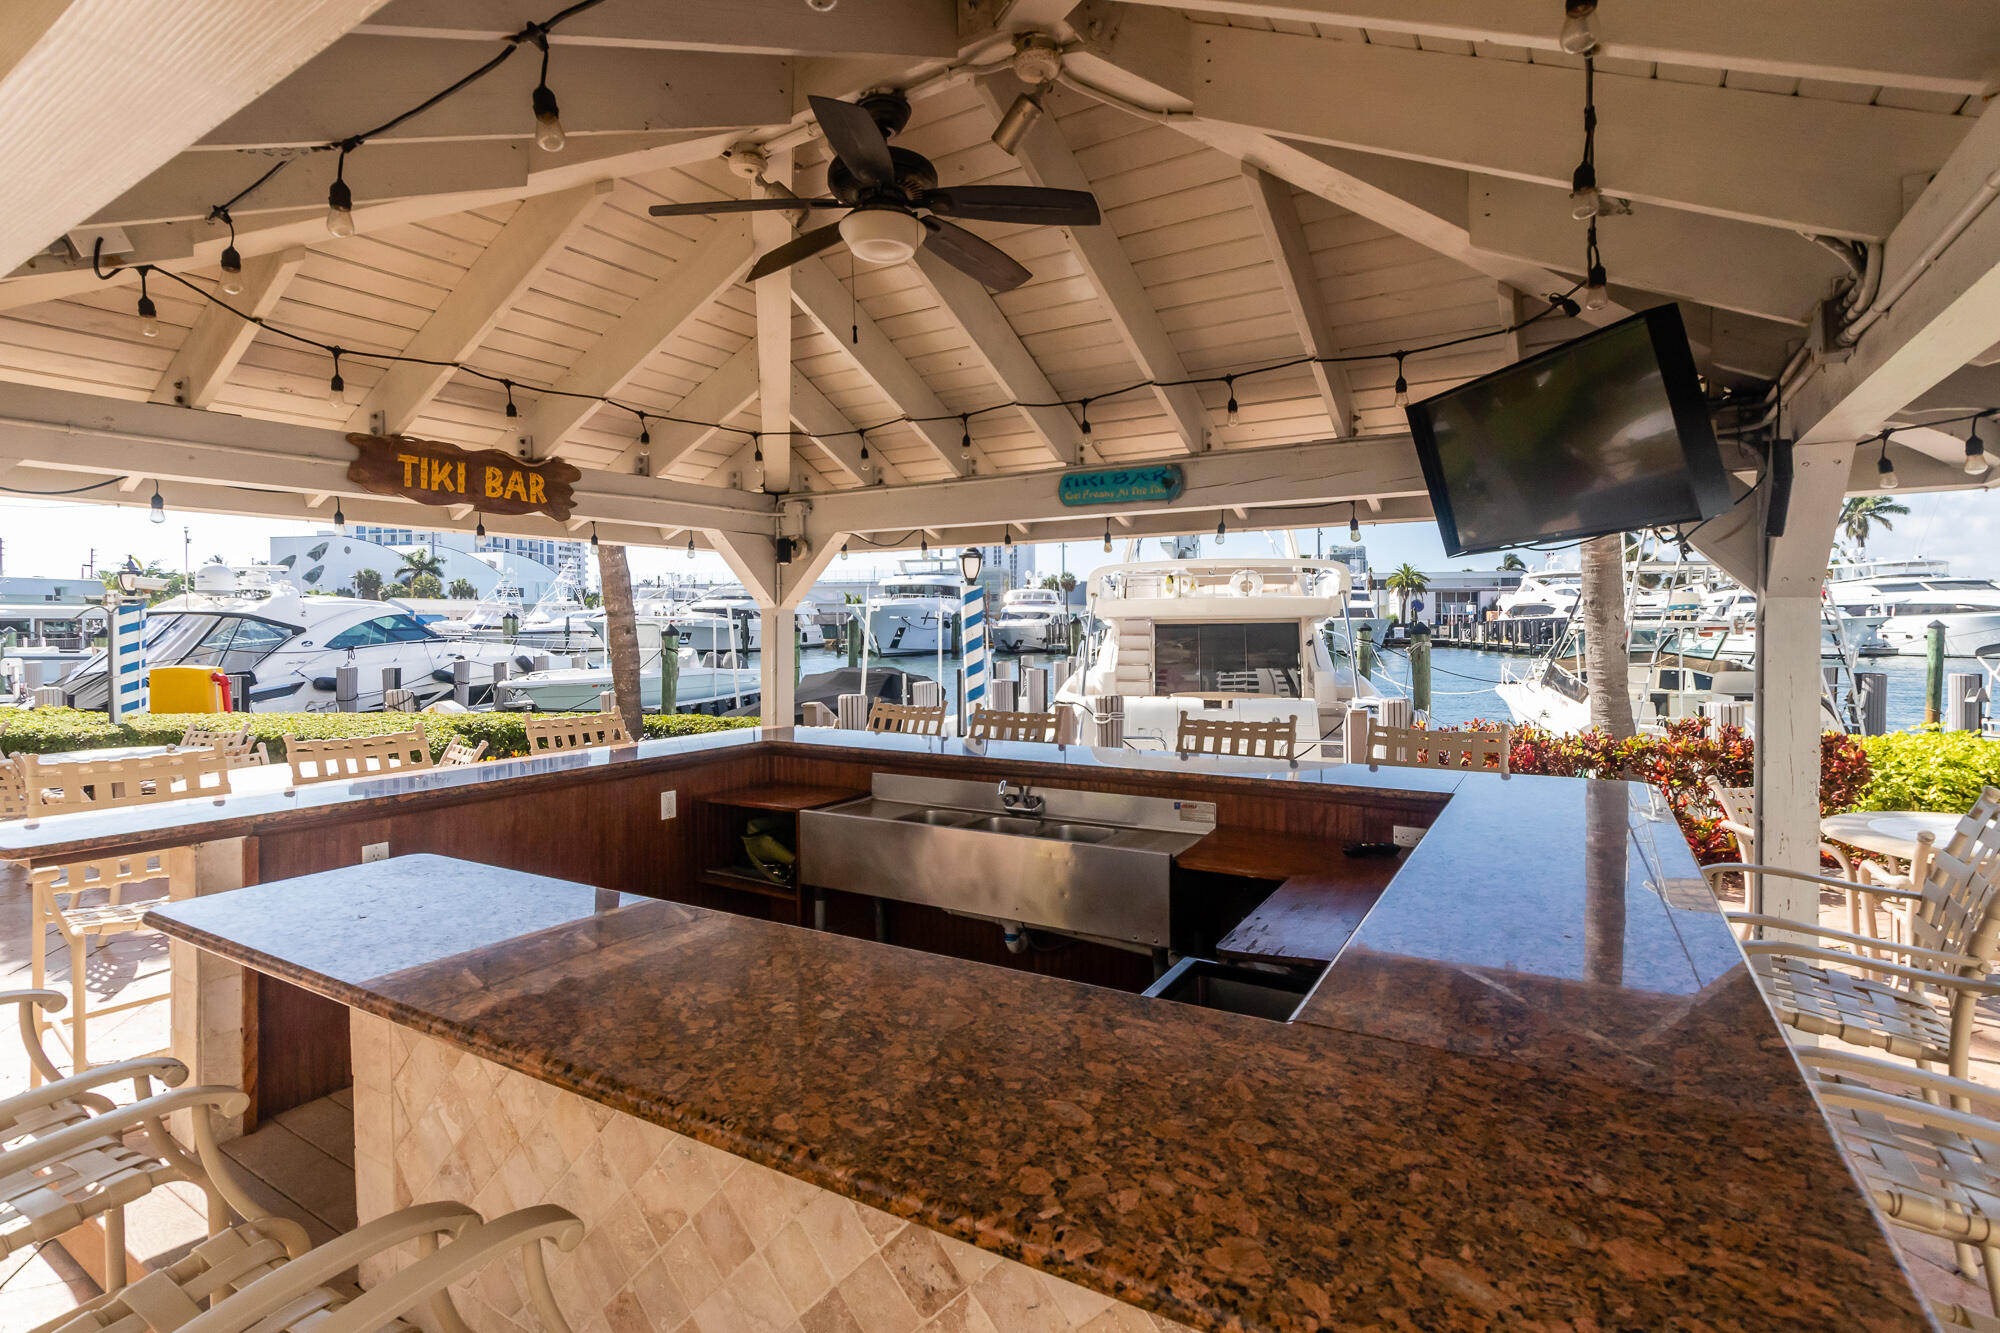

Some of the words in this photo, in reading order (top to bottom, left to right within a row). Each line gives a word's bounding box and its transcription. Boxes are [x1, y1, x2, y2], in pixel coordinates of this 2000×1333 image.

[397, 454, 466, 494] TIKI
[485, 465, 547, 504] BAR
[1063, 475, 1105, 488] TIKI
[1112, 469, 1167, 486] BAR
